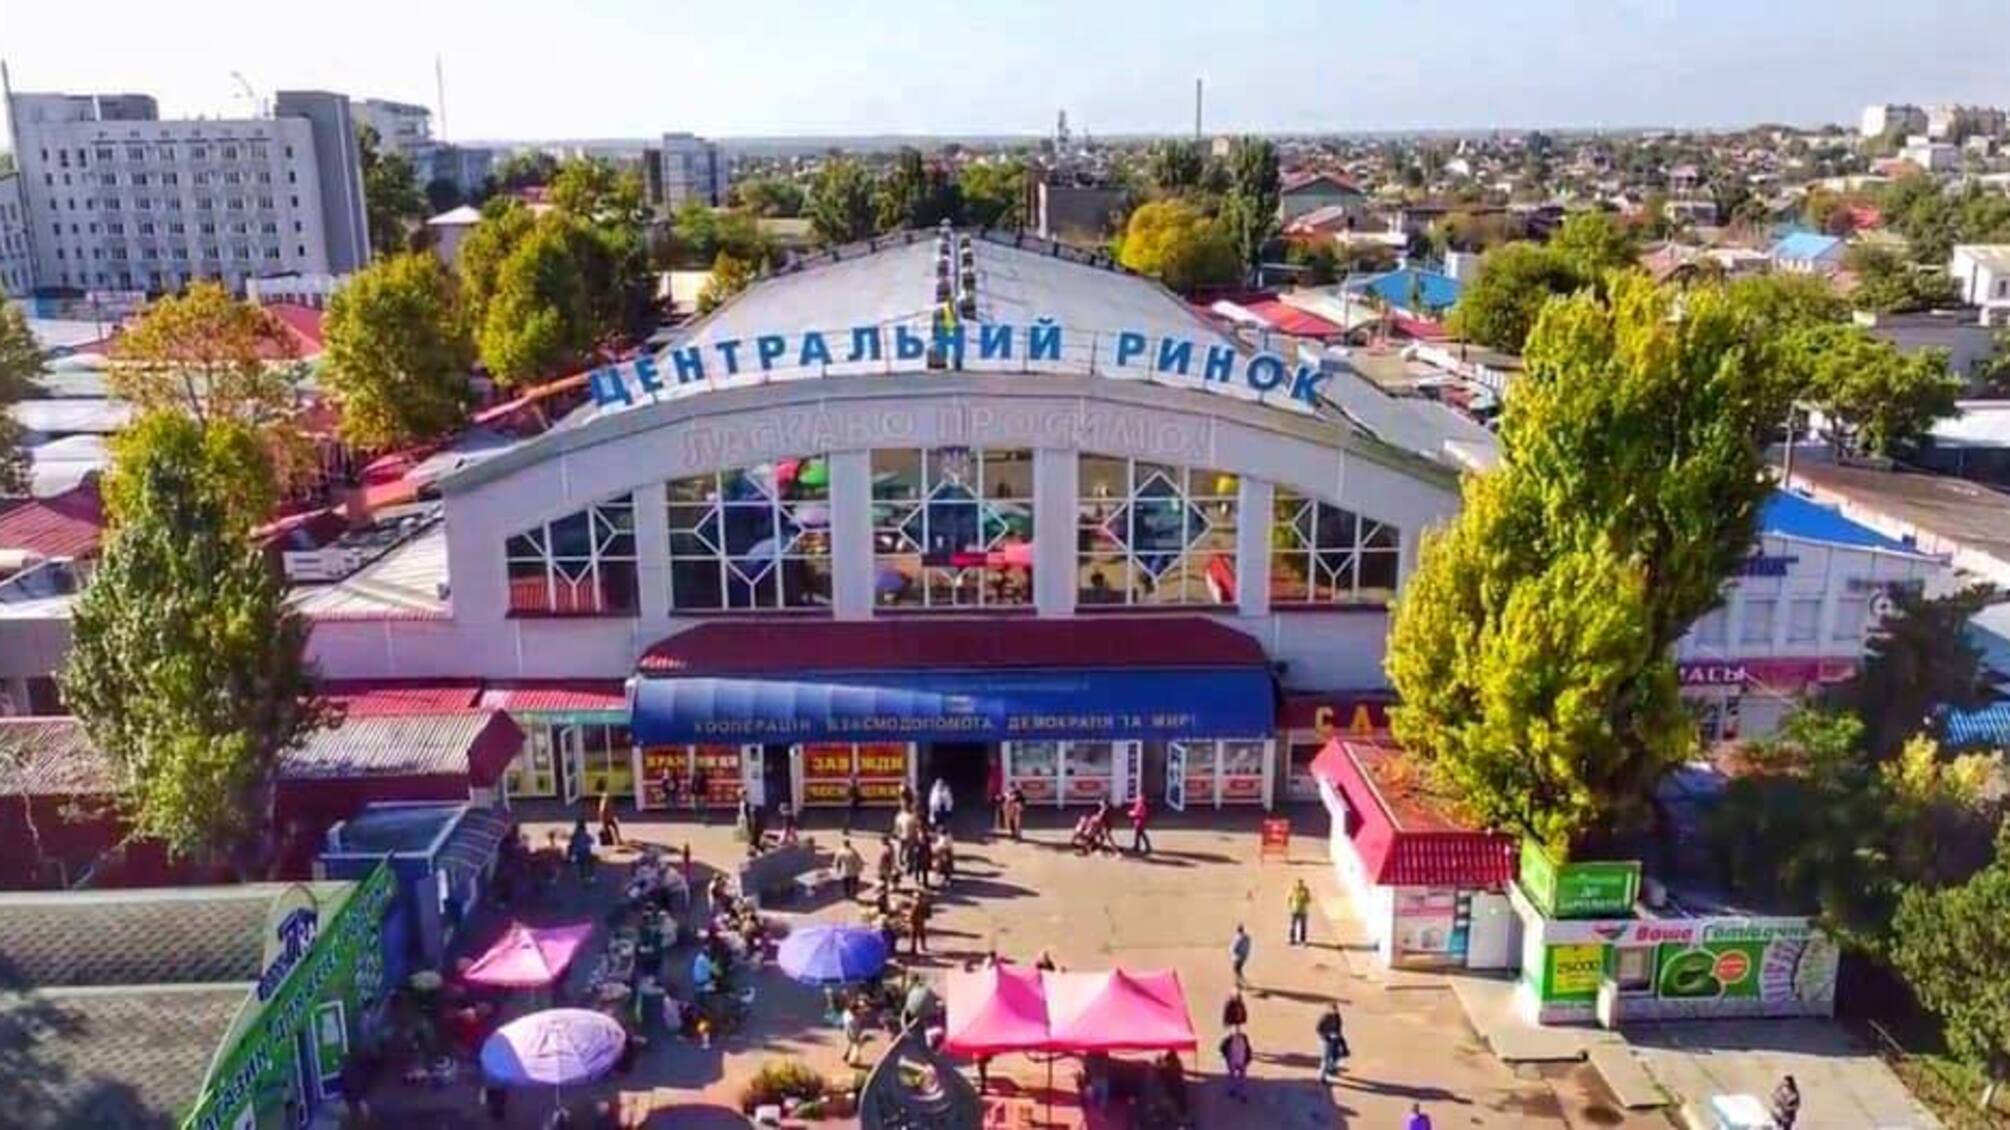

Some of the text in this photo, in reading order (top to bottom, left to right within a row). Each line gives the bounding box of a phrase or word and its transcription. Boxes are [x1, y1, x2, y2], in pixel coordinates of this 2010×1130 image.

[591, 318, 1331, 406] ЦЕНТРАЛЬНИЙ РИНОК
[1680, 657, 1747, 682] АСЫ
[1635, 924, 1693, 942] Ваша
